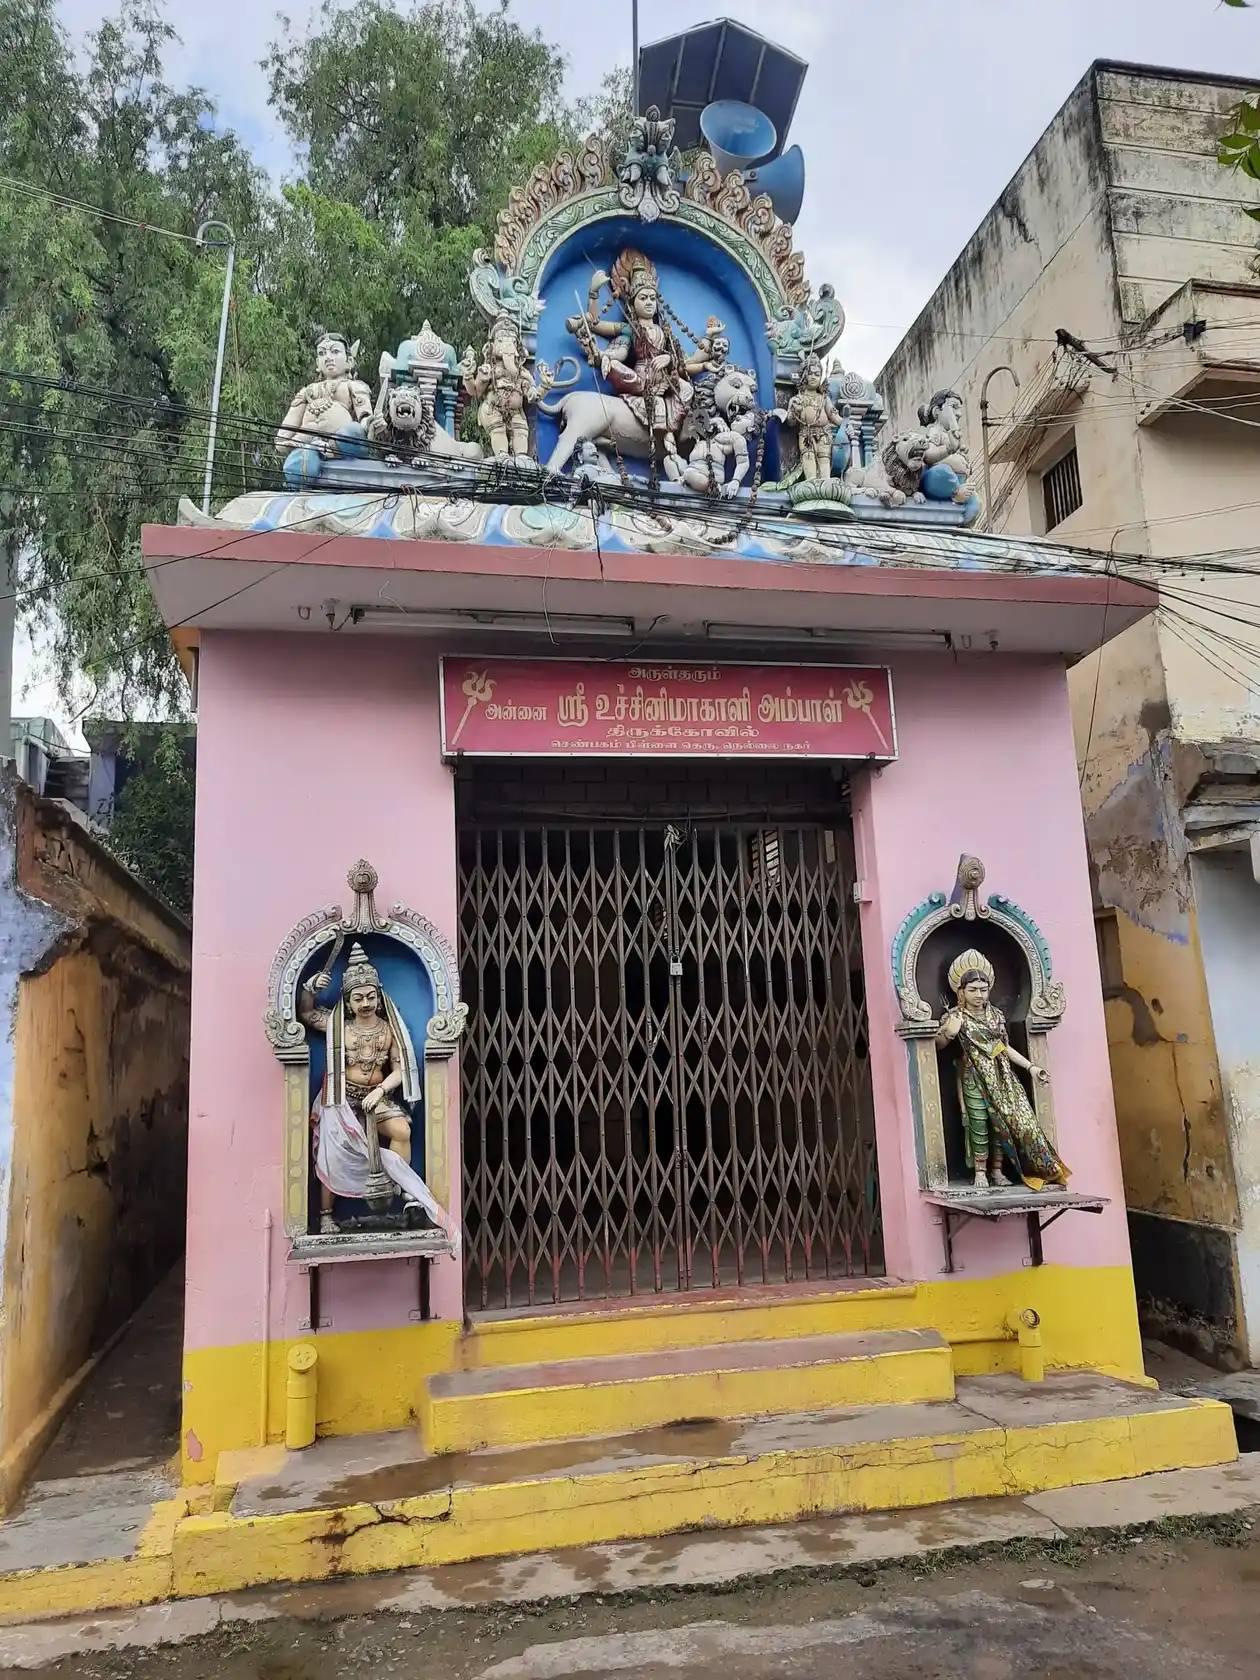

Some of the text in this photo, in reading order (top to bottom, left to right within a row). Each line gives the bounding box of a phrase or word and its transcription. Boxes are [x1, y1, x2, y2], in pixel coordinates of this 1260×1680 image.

[628, 665, 722, 683] அருள்தரும்
[485, 682, 843, 727] அன்னை ஸ்ரீ உச்சினிமாகாளி அம்பாள்
[605, 724, 760, 738] திருக்கோவில்
[783, 740, 811, 752] நகர்
